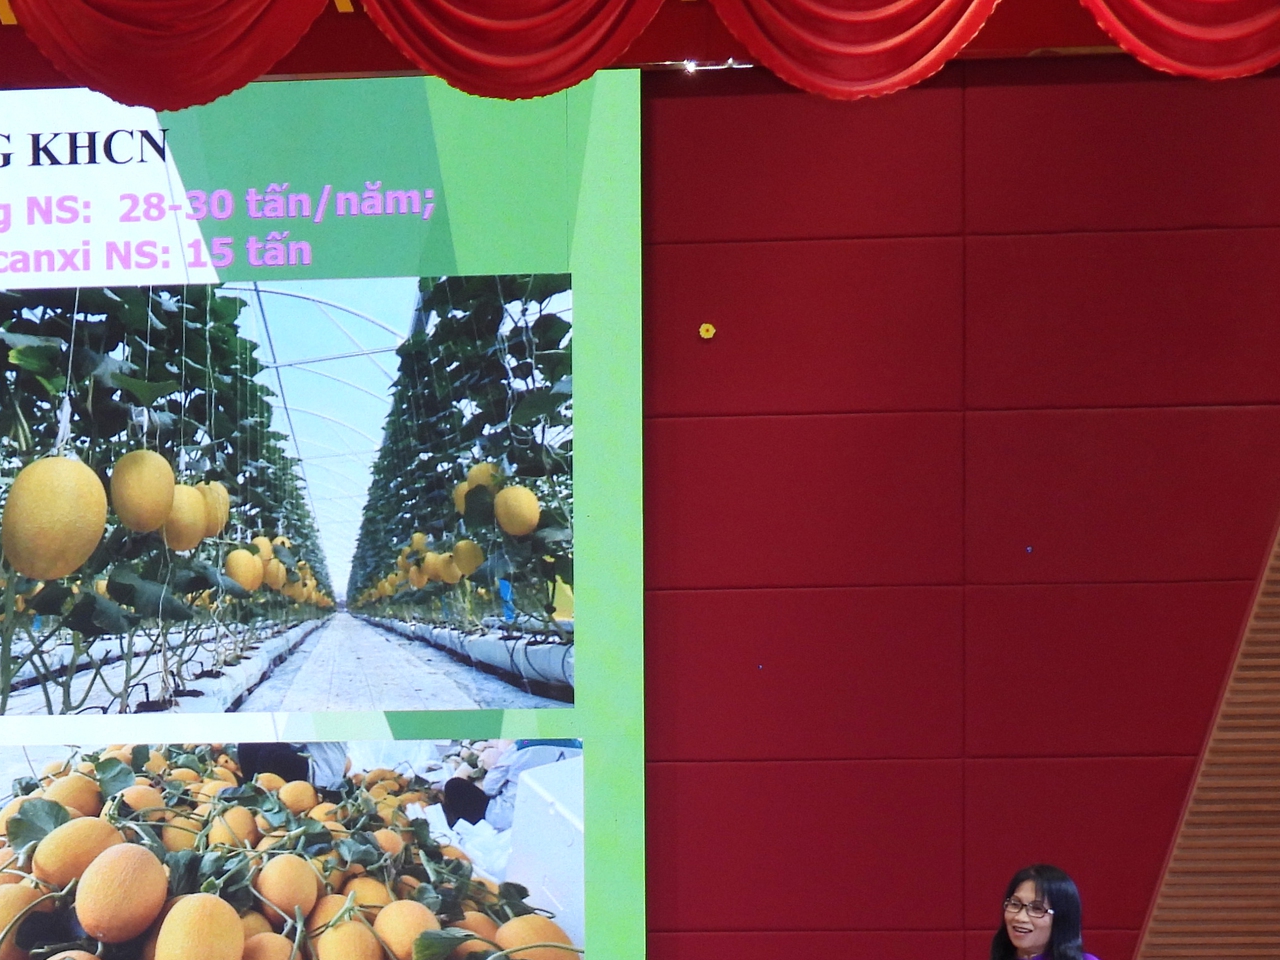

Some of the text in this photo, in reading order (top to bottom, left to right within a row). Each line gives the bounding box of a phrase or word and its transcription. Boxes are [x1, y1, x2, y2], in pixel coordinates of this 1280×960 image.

[27, 128, 170, 166] KHCN
[27, 195, 92, 226] NS:
[118, 189, 234, 224] 28-30
[105, 239, 170, 270] NS:
[186, 236, 234, 268] 15
[245, 231, 311, 266] tấn
